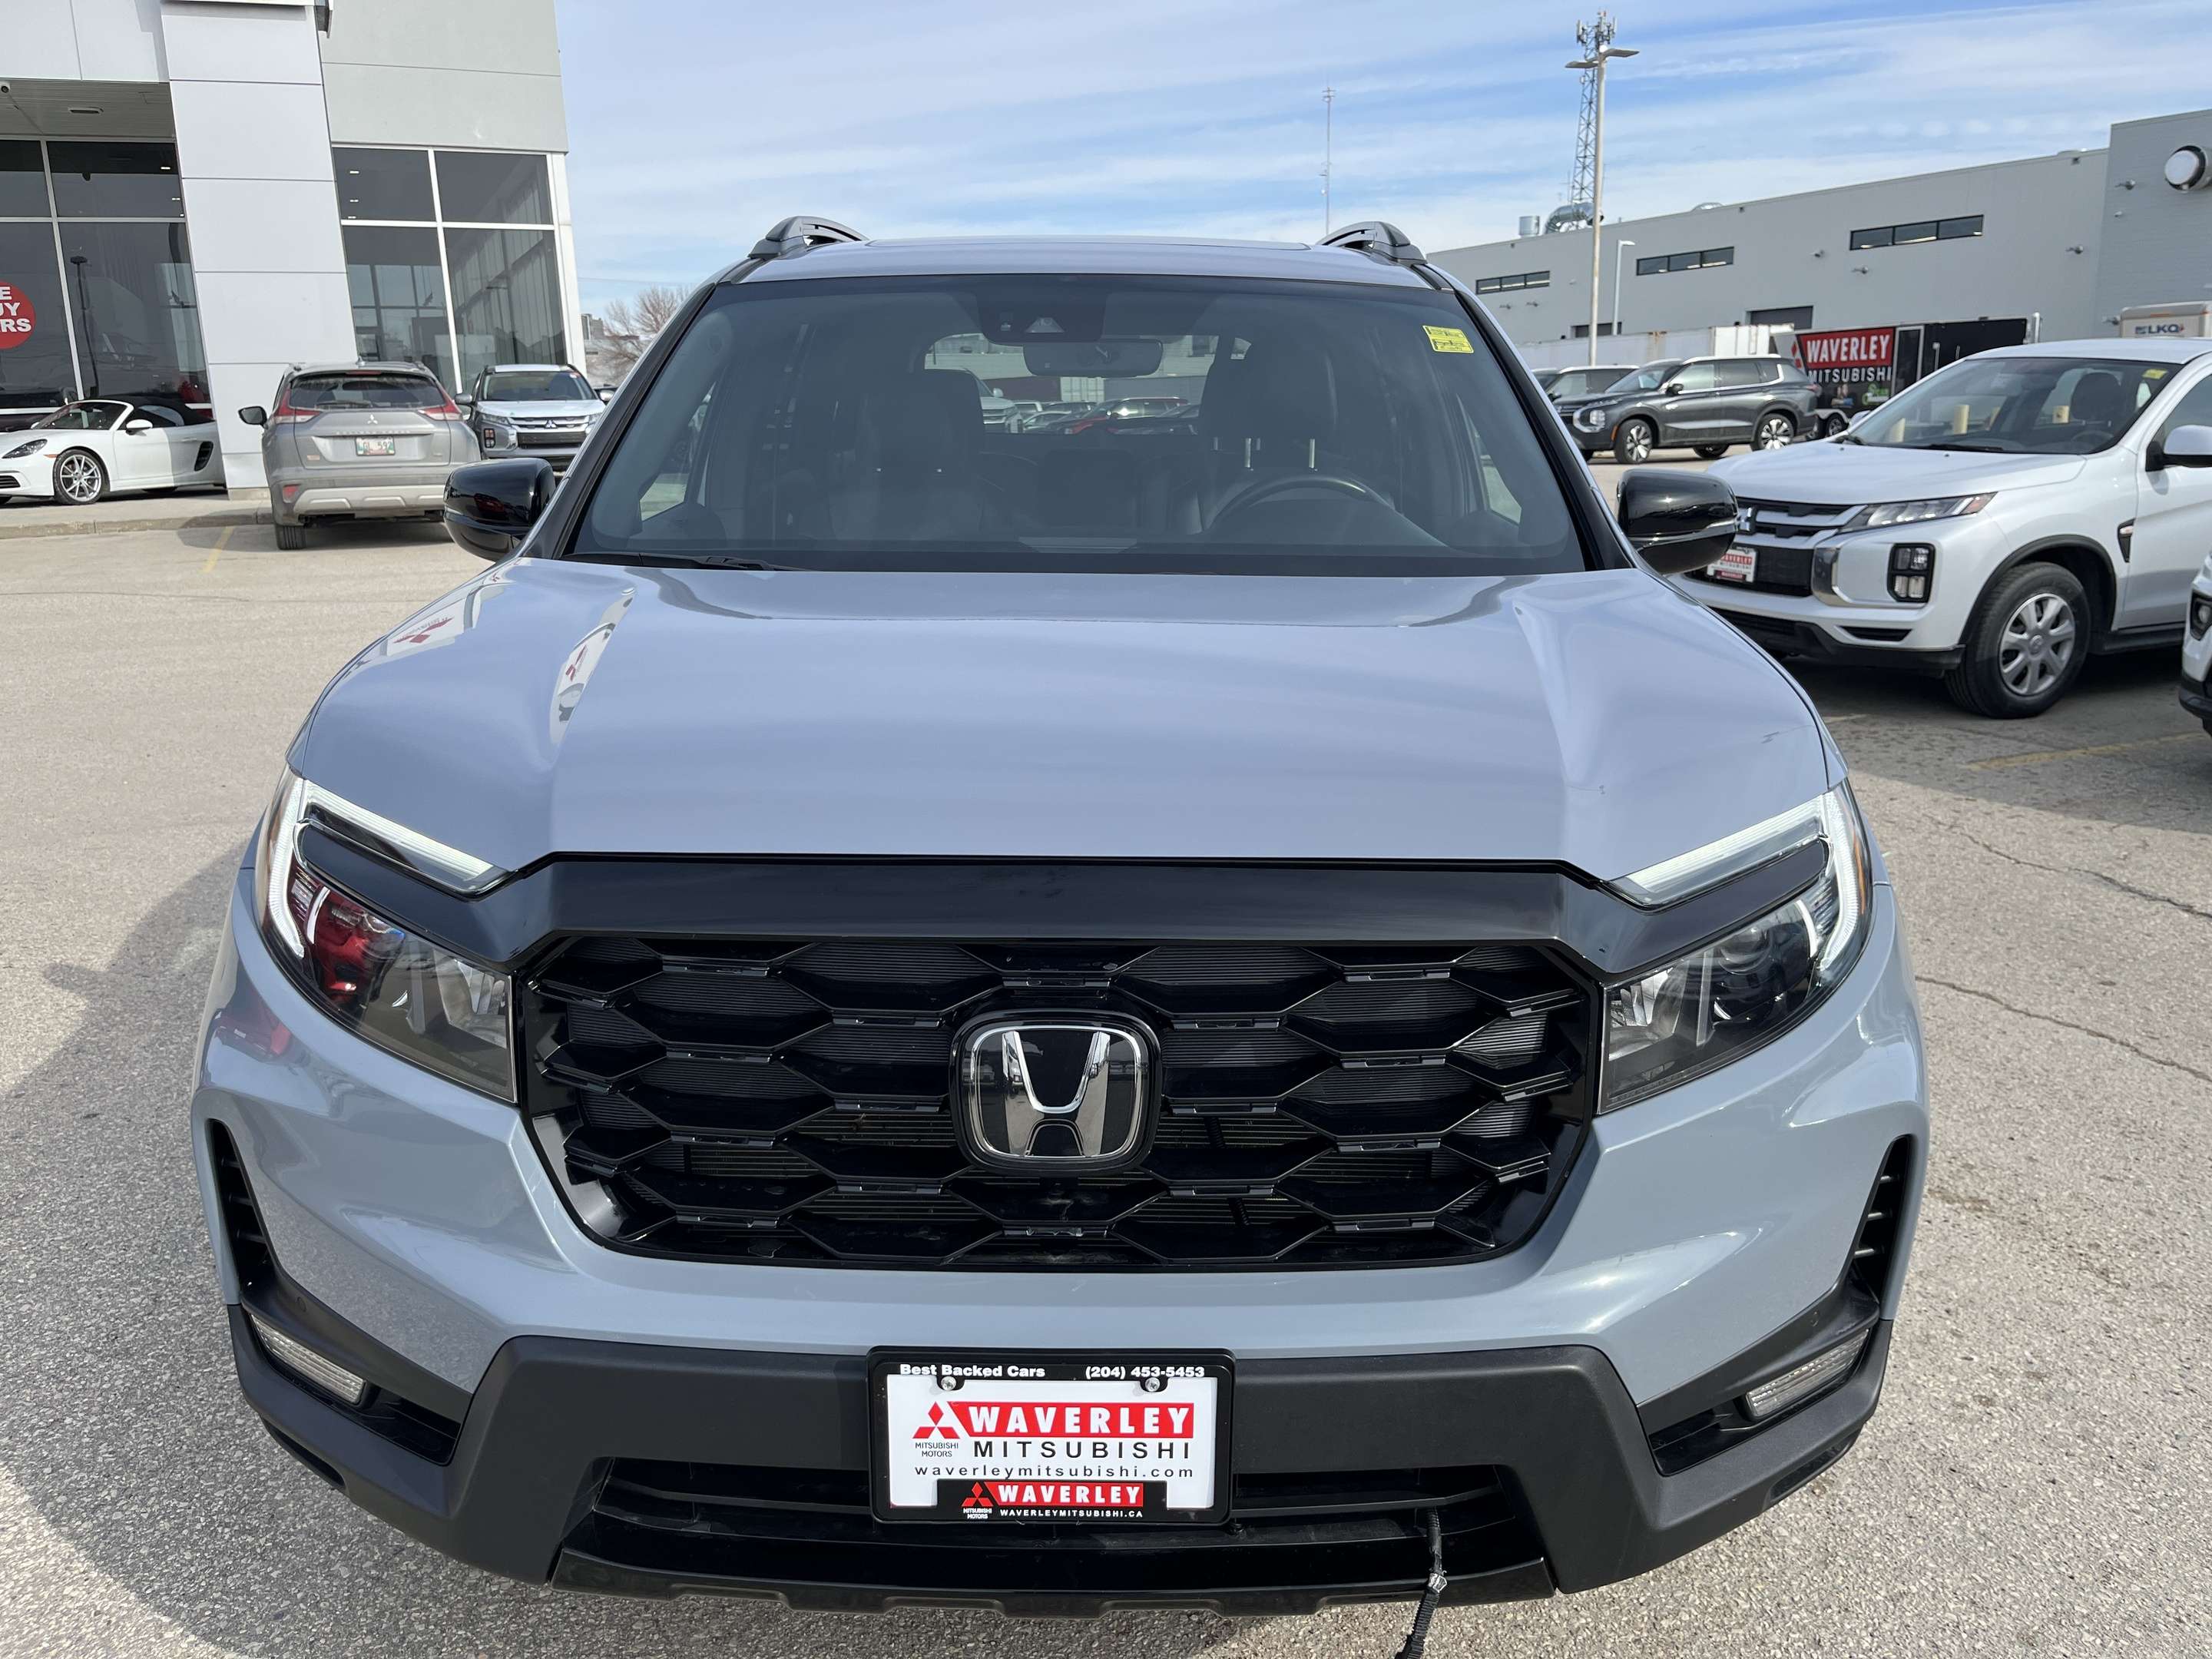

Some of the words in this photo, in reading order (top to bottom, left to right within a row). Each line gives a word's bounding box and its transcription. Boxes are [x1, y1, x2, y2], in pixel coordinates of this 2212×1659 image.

[1806, 335, 1890, 363] WAVERLEY
[1808, 366, 1892, 382] MITSUBISHI
[899, 1364, 937, 1376] Best
[942, 1365, 1002, 1377] Backed
[1007, 1365, 1045, 1378] Cars
[1085, 1366, 1126, 1379] (204)
[1131, 1366, 1205, 1378] 453-5453
[968, 1406, 1190, 1434] WAVERLEY
[974, 1441, 1189, 1459] MITSUBISHI
[915, 1464, 1194, 1480] waverleymitsubishi.com
[998, 1485, 1141, 1504] WAVERLEY
[1000, 1508, 1144, 1518] WAVERLEYMITSUBISHI.CA
